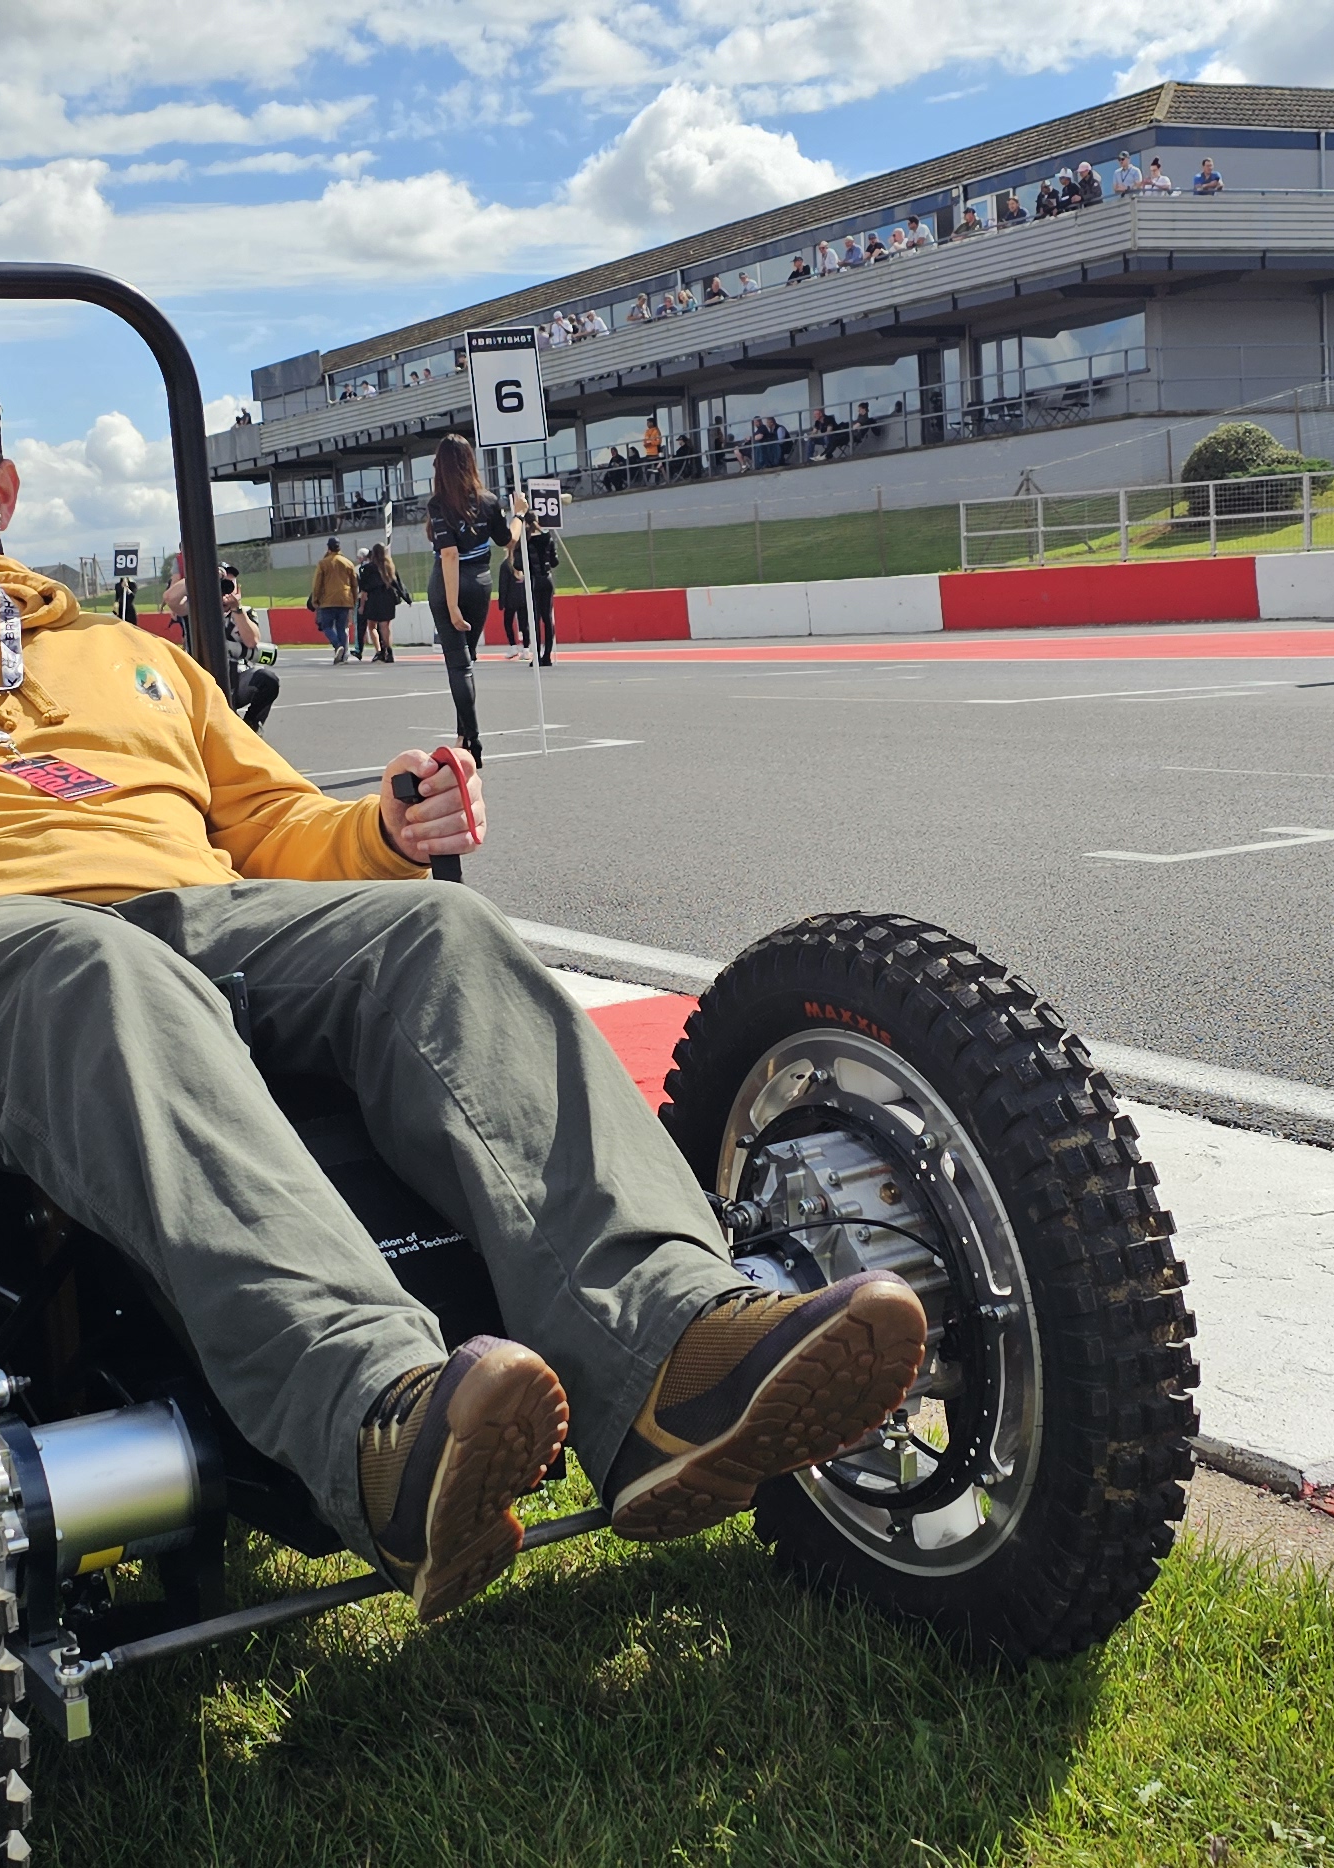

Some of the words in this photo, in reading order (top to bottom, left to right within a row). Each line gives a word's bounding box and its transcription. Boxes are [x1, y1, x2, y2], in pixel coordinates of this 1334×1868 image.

[495, 380, 524, 413] 6
[534, 498, 558, 516] 56
[116, 554, 138, 569] 90
[804, 1001, 892, 1047] MAXXIS
[406, 1232, 418, 1242] of
[399, 1242, 420, 1254] and
